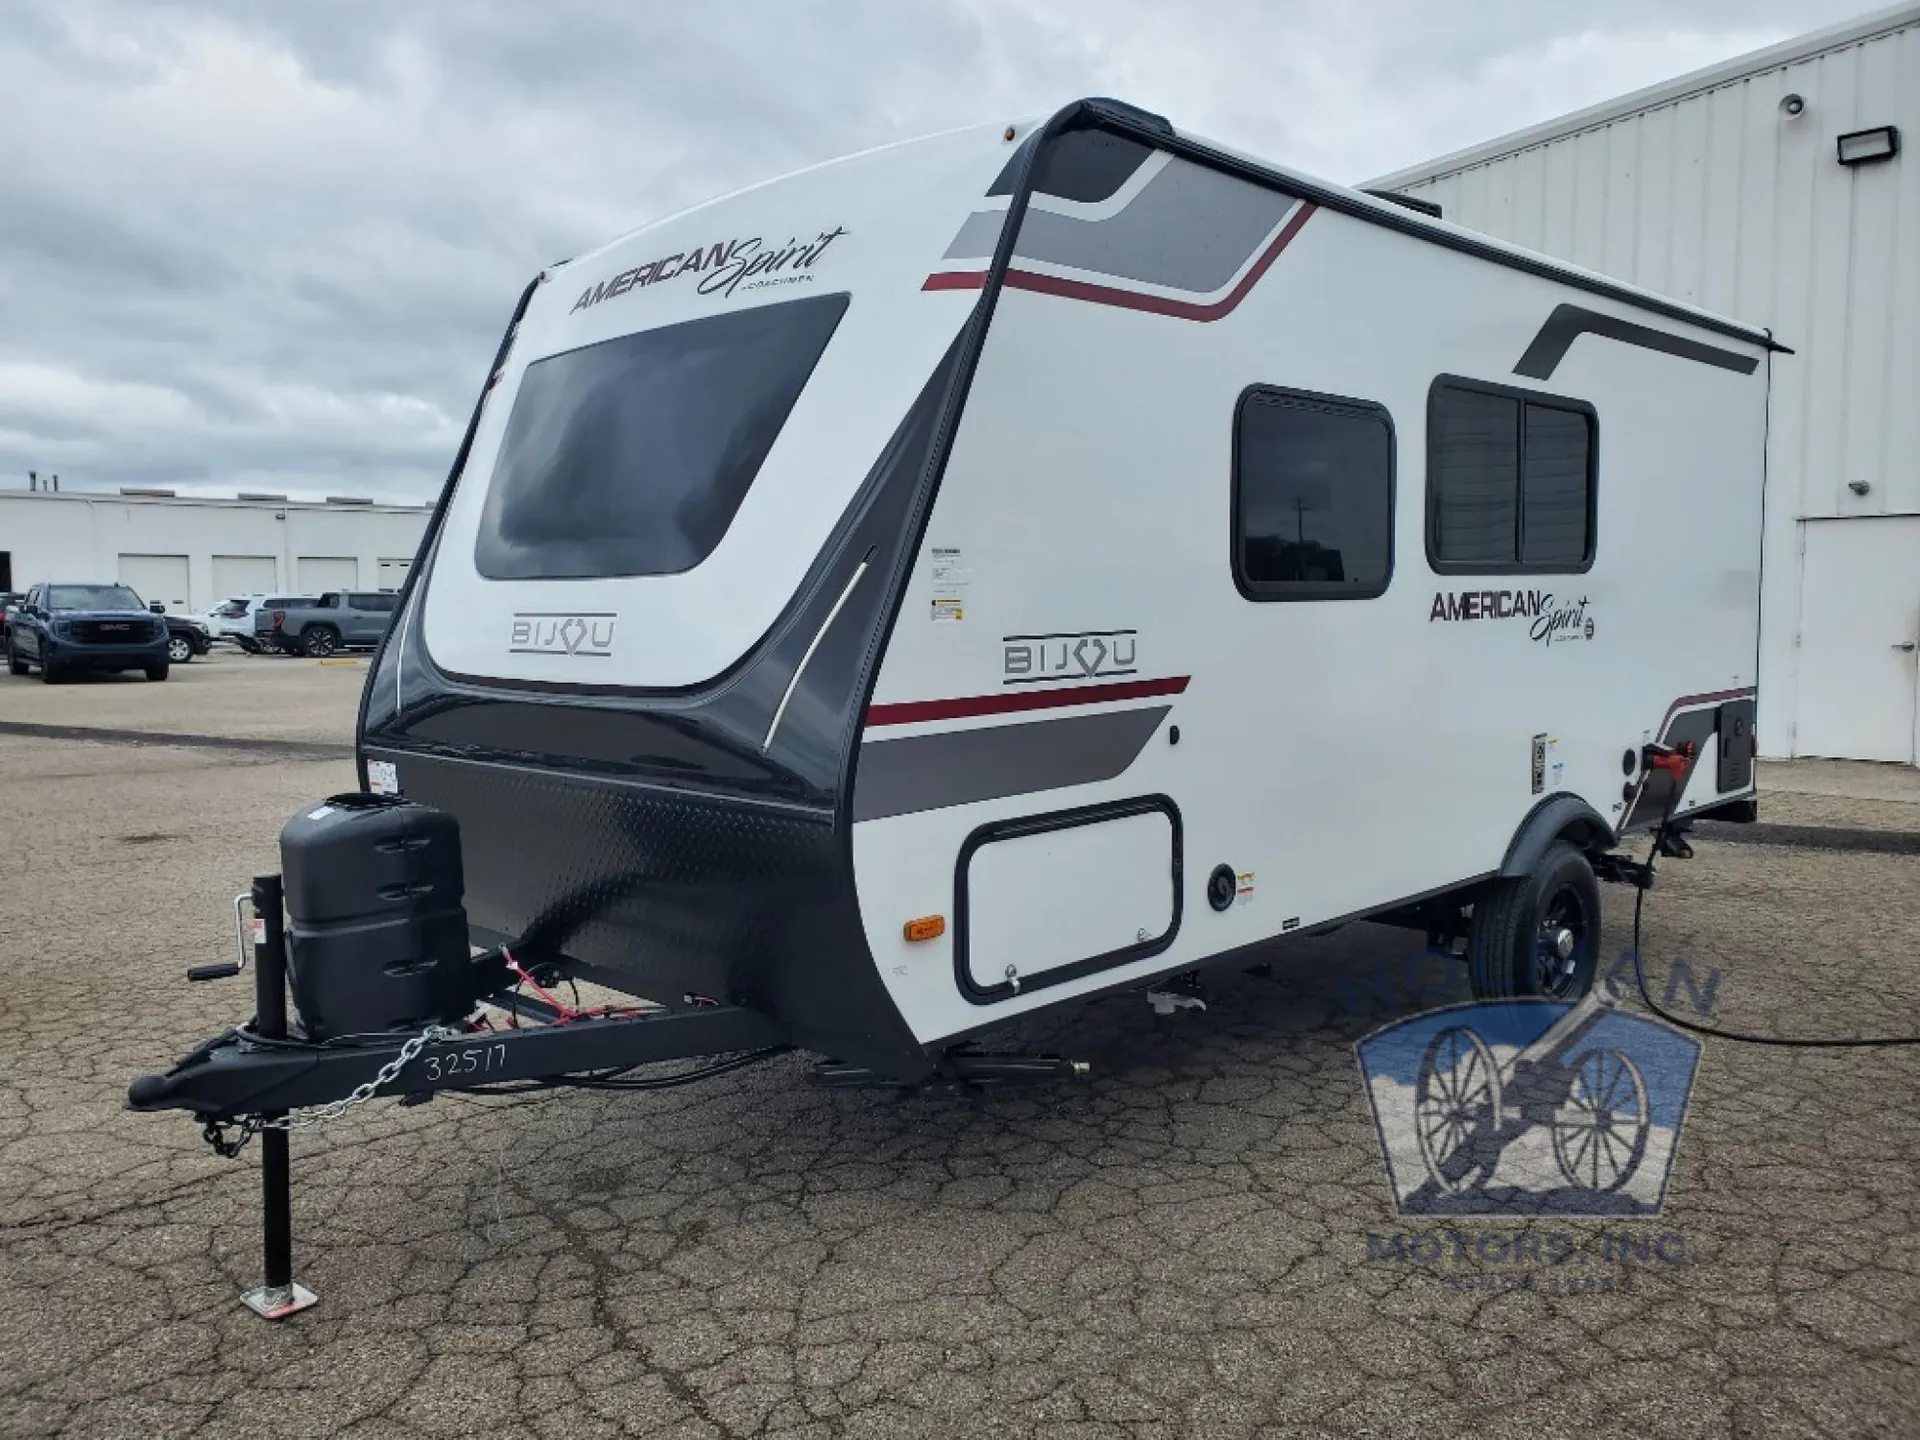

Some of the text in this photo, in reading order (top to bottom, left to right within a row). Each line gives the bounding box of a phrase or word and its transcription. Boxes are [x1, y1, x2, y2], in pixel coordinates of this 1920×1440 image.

[570, 226, 851, 315] AMERICAN Spirit
[511, 618, 614, 656] BIJOU
[1429, 590, 1590, 647] AMERICAN Spirit
[1004, 638, 1136, 678] BIJOU
[424, 1044, 506, 1081] 32517
